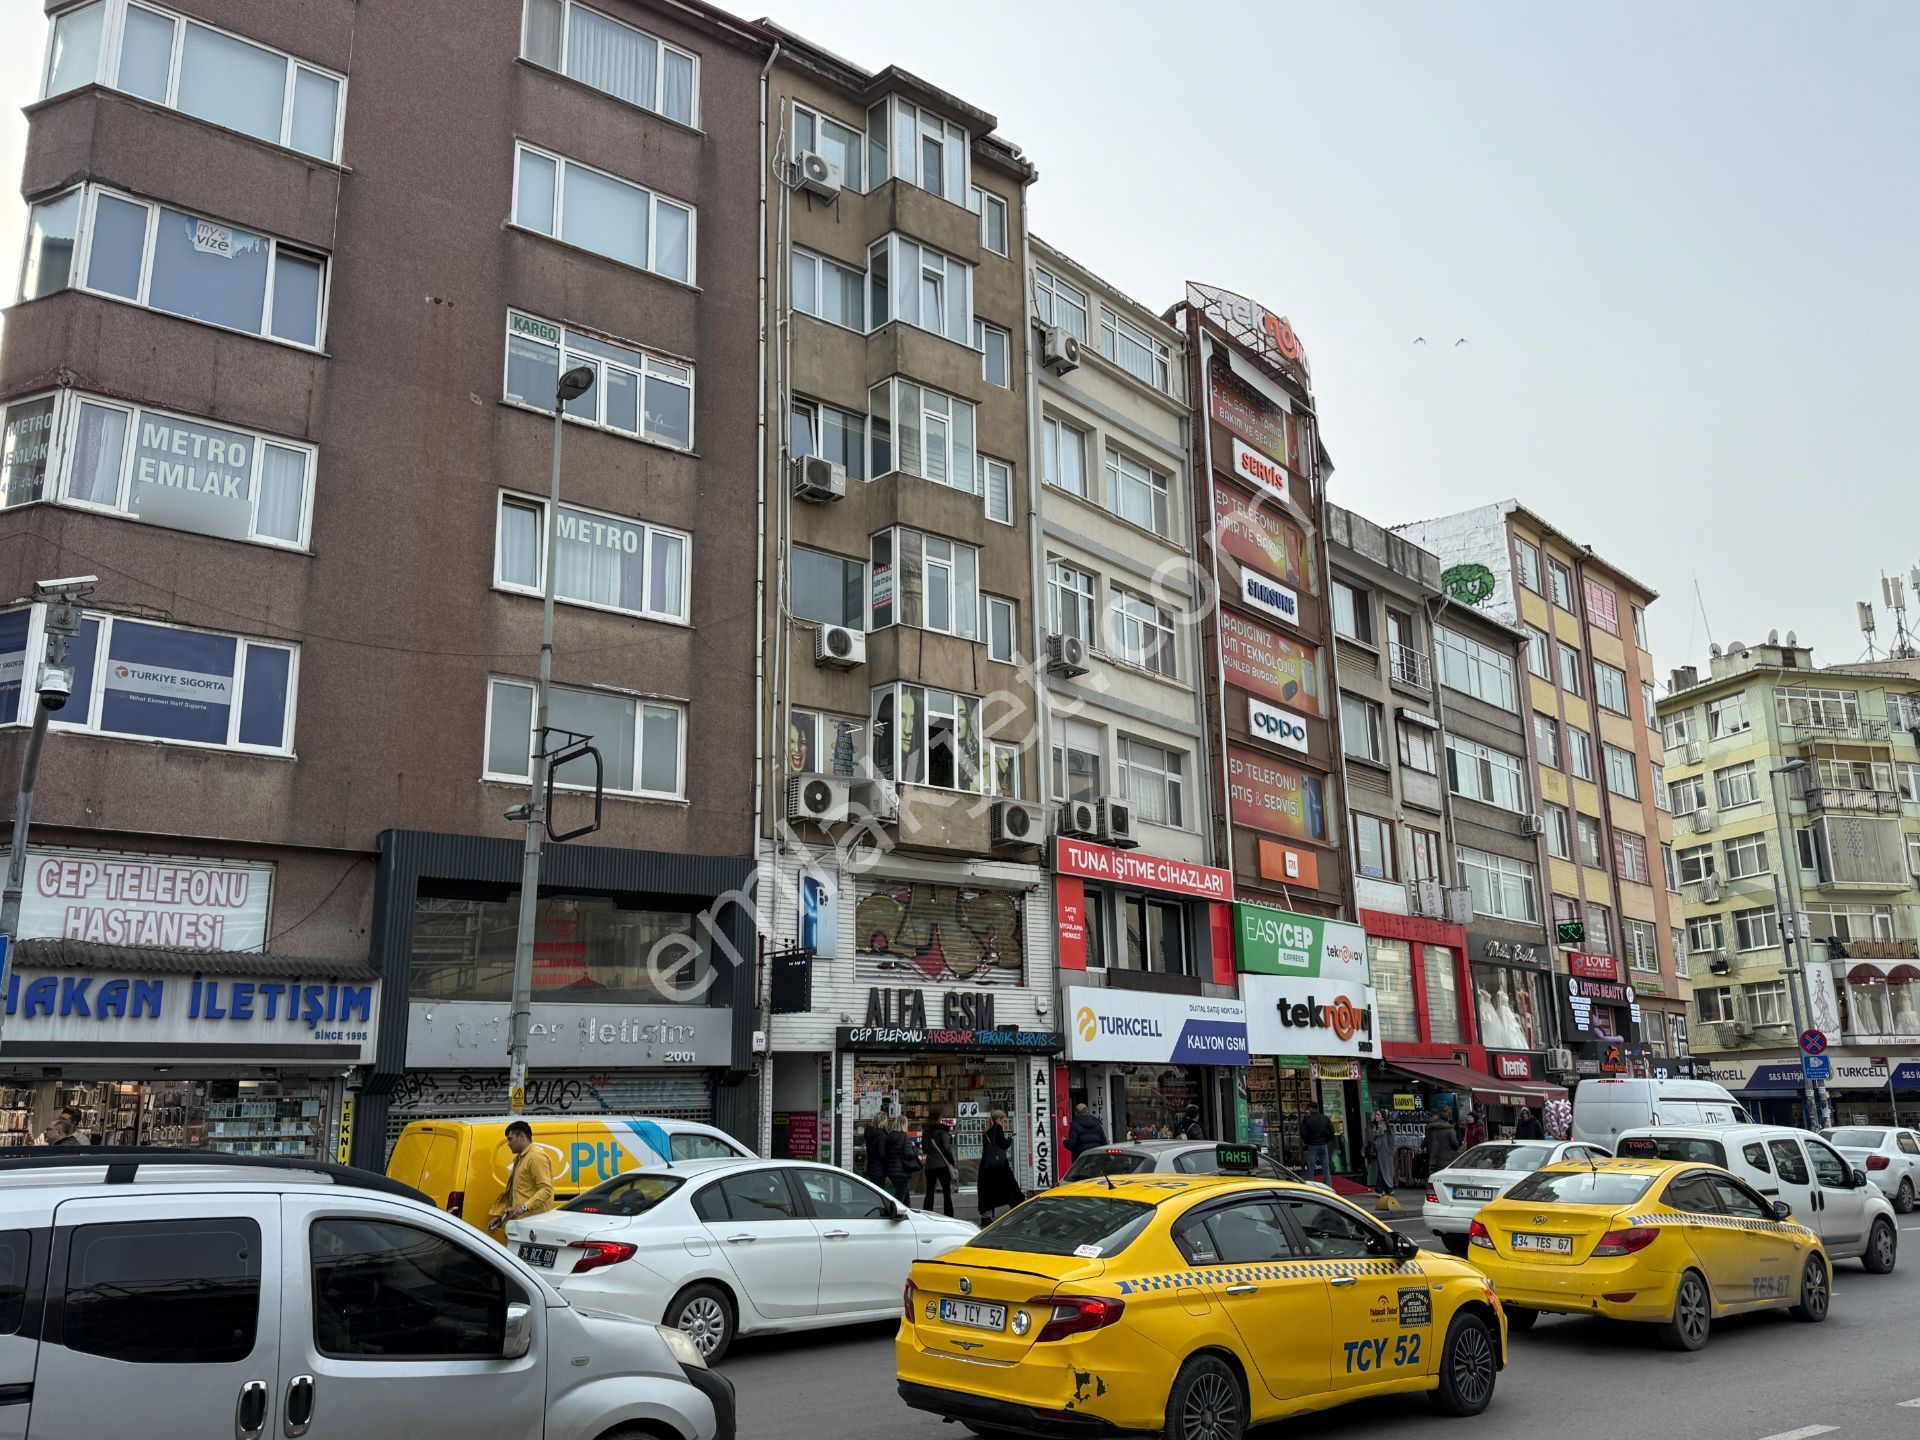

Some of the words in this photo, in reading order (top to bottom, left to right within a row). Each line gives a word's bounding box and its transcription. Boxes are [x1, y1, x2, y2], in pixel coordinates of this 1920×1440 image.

[513, 316, 557, 342] KARGO
[1222, 391, 1233, 407] EL
[8, 412, 53, 437] METRO
[1219, 407, 1243, 430] BAKIM
[1243, 422, 1254, 437] VE
[141, 422, 246, 468] METRO
[138, 456, 242, 499] EMLAK
[1231, 499, 1279, 535] TELEFONU
[556, 514, 639, 553] METRO
[1242, 525, 1254, 543] VE
[1248, 578, 1295, 615] SAMSUNG
[1245, 762, 1296, 792] TELEFONU
[1068, 847, 1109, 873] TUNA
[1112, 852, 1156, 880] İŞİTME
[1158, 861, 1224, 892] CİHAZLARI
[38, 860, 98, 898] CEP
[103, 863, 250, 908] TELEFONU
[64, 906, 225, 949] HASTANESİ
[1246, 916, 1314, 949] EASYCEP
[1283, 952, 1305, 963] EXPRESS
[1580, 981, 1600, 998] LOTUS
[1600, 984, 1624, 1000] BEAUTY
[865, 987, 927, 1028] ALFA
[944, 991, 995, 1031] GSM
[346, 1031, 367, 1040] 1995
[850, 1028, 872, 1041] CEP
[1098, 1015, 1163, 1037] TURKCELL
[1187, 1034, 1224, 1050] KALYON
[1226, 1036, 1246, 1051] GSM
[664, 1051, 696, 1063] 2001
[1502, 1056, 1528, 1077] hemis
[1768, 1073, 1781, 1081] S&S
[1837, 1067, 1886, 1077] TURKCELL
[1902, 1071, 1915, 1079] S&S
[1035, 1069, 1047, 1137] ALFA
[570, 1140, 625, 1183] Ptt
[1037, 1142, 1050, 1187] GSM
[1517, 1236, 1529, 1247] 34
[1535, 1237, 1552, 1249] TES
[1558, 1239, 1570, 1250] 67
[1753, 1276, 1775, 1298] TES
[1778, 1274, 1790, 1297] 67
[945, 1302, 958, 1320] 34
[964, 1304, 981, 1322] TCY
[989, 1308, 1002, 1327] 52
[1344, 1337, 1388, 1373] TCY
[1393, 1332, 1422, 1367] 52
